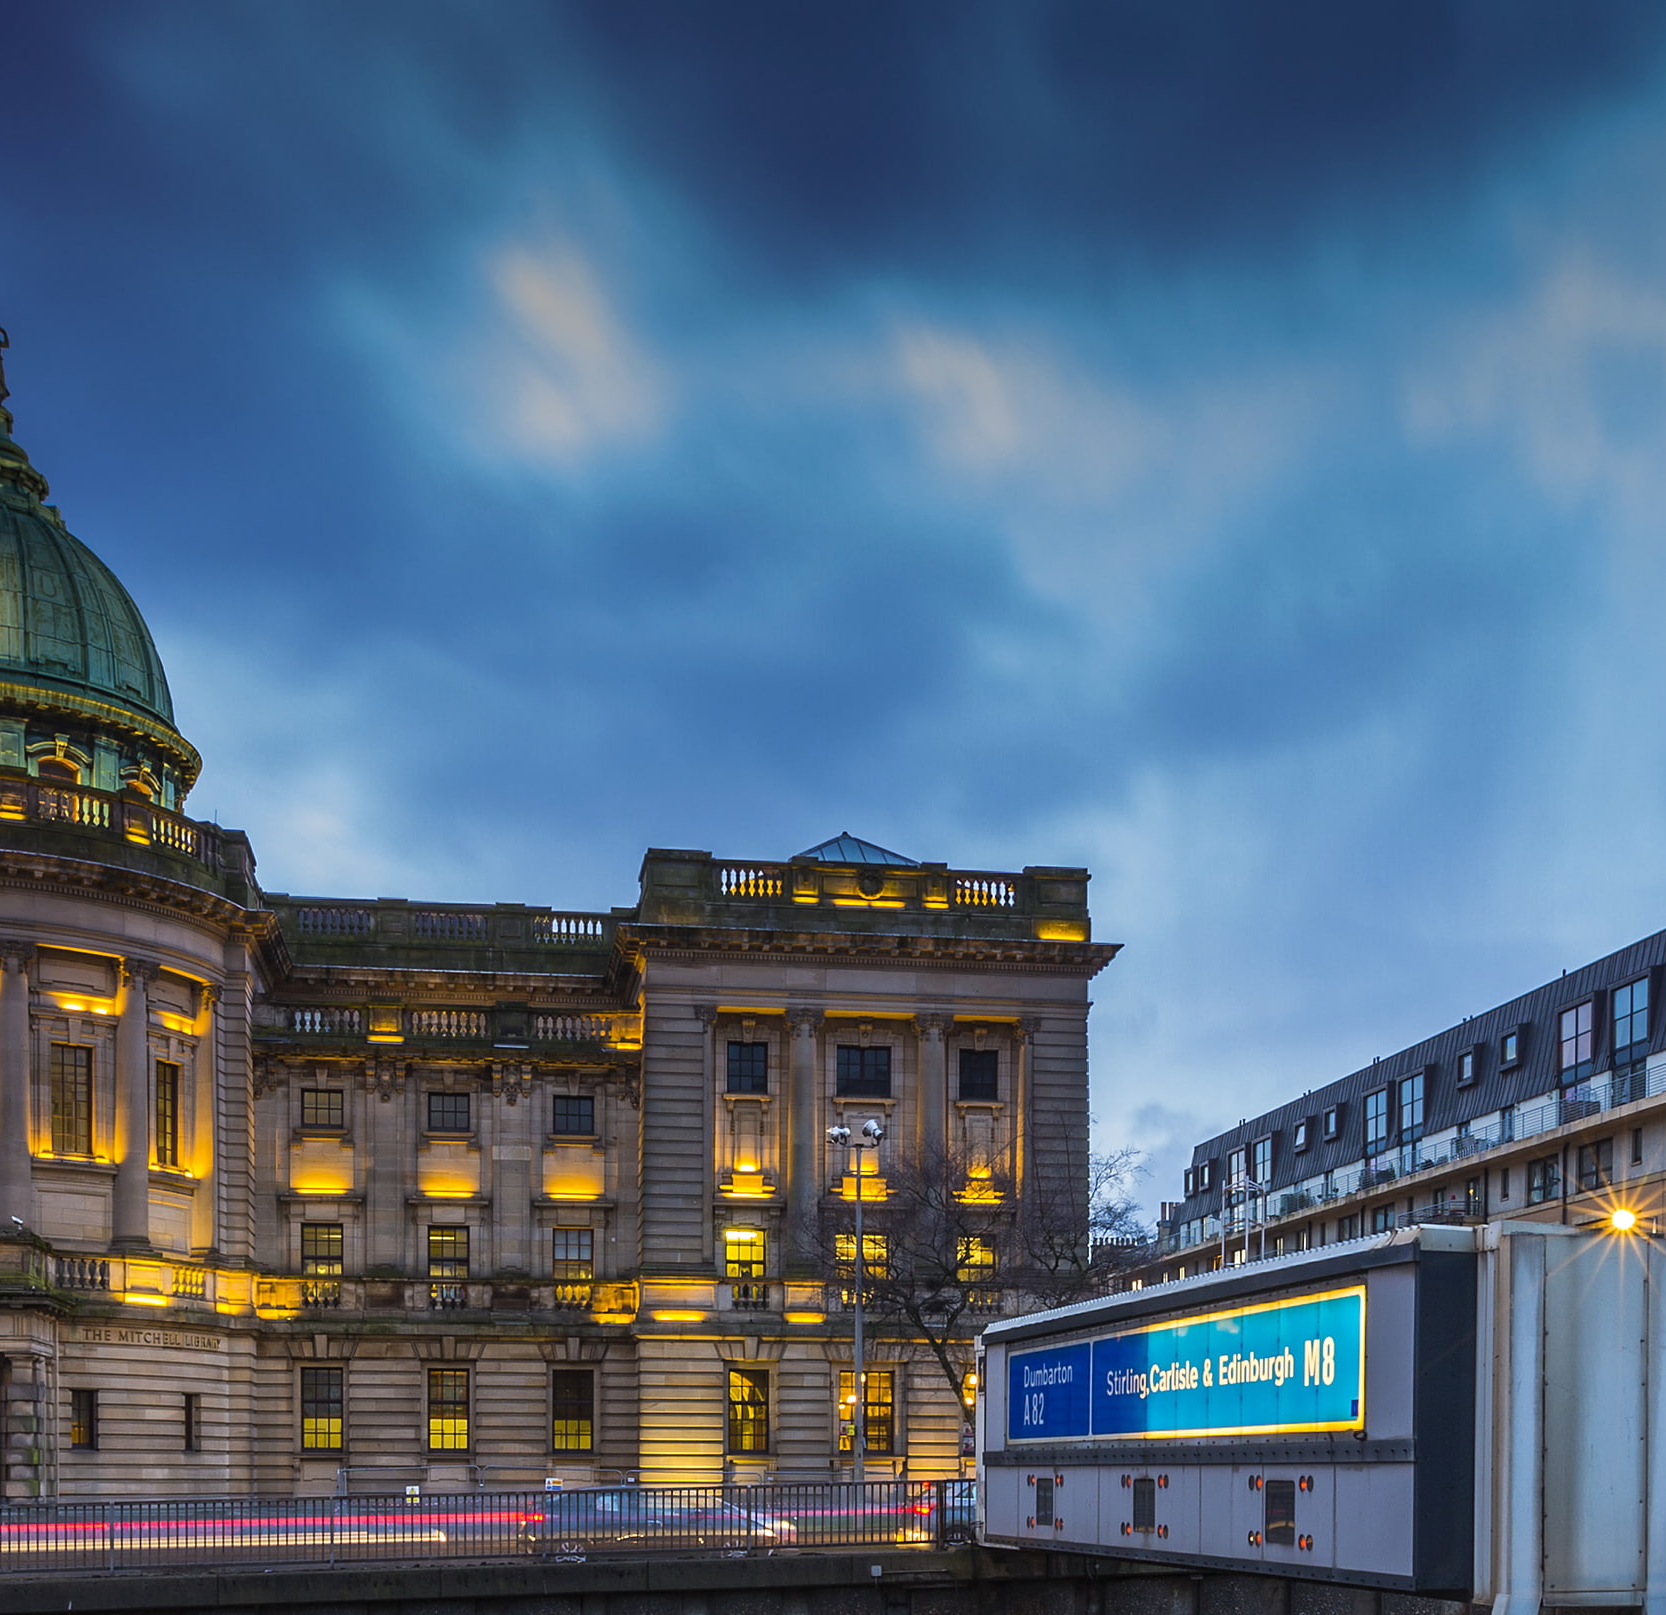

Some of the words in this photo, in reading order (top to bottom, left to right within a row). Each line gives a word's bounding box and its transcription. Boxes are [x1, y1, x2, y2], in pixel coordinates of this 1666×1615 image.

[82, 1328, 111, 1341] THE
[118, 1330, 181, 1346] MITCHELL
[184, 1335, 221, 1350] LIBRARY
[1023, 1361, 1073, 1388] Dumbarton
[1202, 1358, 1214, 1387] &
[1218, 1347, 1294, 1386] Edinburgh
[1303, 1336, 1335, 1387] M8
